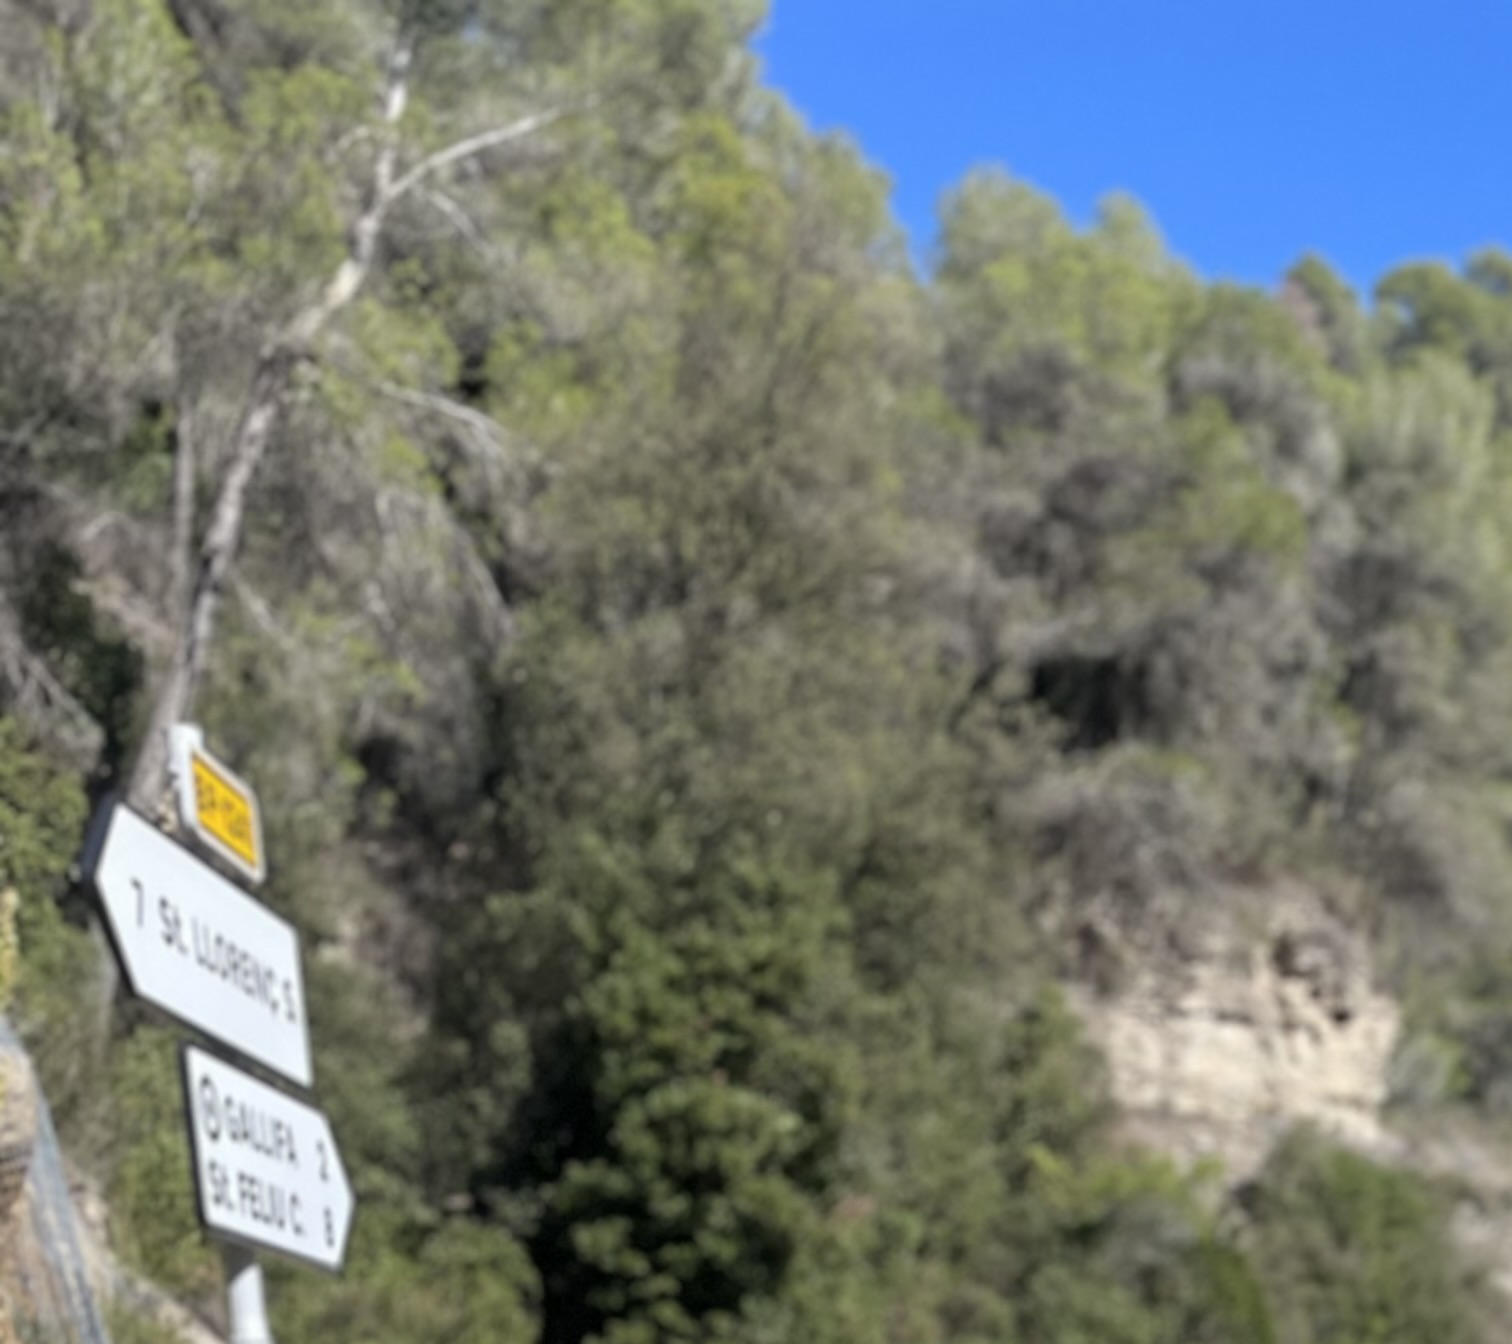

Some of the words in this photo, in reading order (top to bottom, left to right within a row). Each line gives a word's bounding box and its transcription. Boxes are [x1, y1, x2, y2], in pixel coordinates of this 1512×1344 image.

[131, 876, 144, 927] 7
[158, 896, 188, 955] St.
[191, 916, 278, 1013] LLORENÇ
[224, 1096, 300, 1169] GALLIFA
[316, 1141, 328, 1182] 2
[238, 1172, 285, 1229] FELIU
